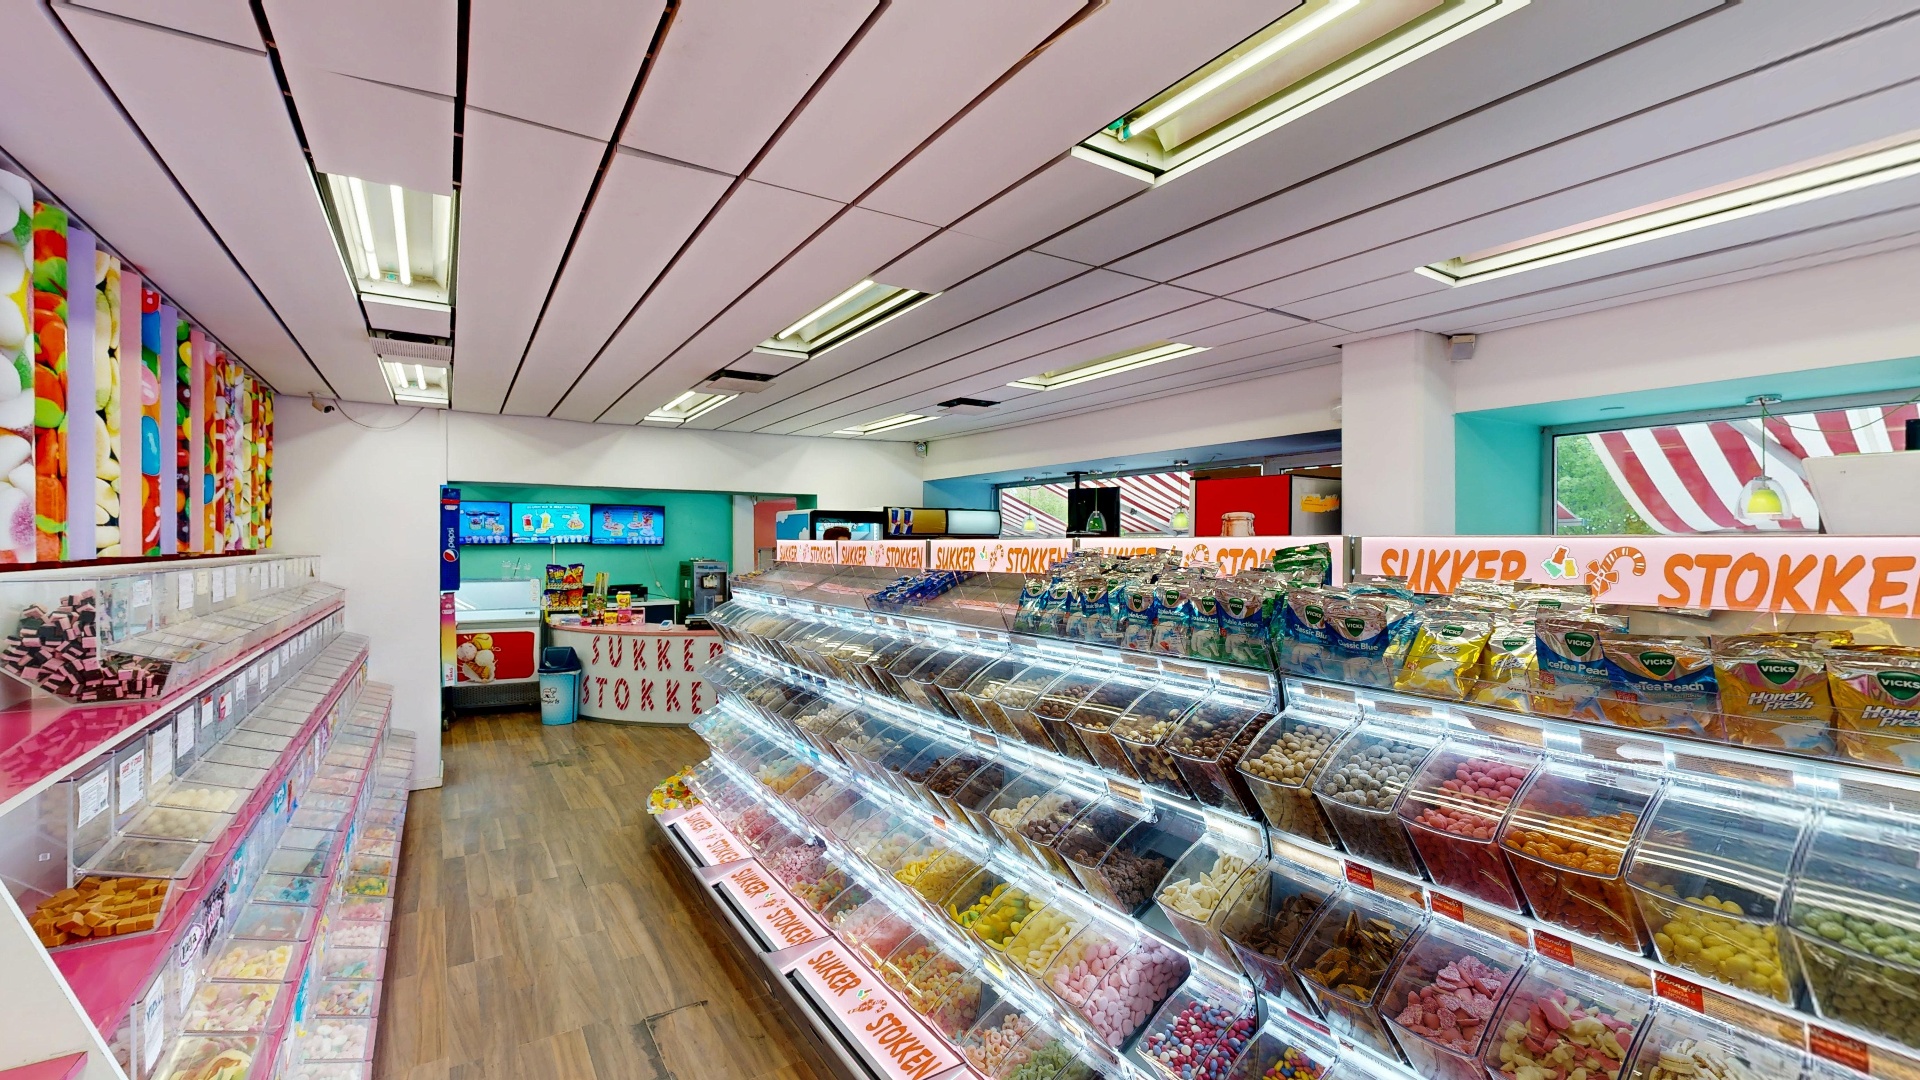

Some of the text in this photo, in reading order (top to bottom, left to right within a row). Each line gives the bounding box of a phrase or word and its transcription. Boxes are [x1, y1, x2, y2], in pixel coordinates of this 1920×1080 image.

[447, 527, 456, 549] pepsi
[780, 545, 835, 563] SUKKER STOKKEN
[841, 546, 924, 568] SUKKER STOKKEN
[935, 546, 976, 571] SUKKER
[1380, 548, 1527, 593] SUKKER
[1657, 552, 1920, 618] STOKKE
[1306, 610, 1322, 619] VICKS
[1294, 623, 1328, 640] Classic Blu
[1441, 628, 1463, 636] VICKS
[1338, 640, 1379, 652] Classic Blue
[1567, 639, 1592, 648] VICKS
[1547, 660, 1577, 672] IceTea
[1760, 665, 1796, 673] VICKS
[1664, 682, 1705, 693] Peach
[1881, 678, 1920, 690] VICKS
[583, 675, 719, 714] STOKKE
[1747, 692, 1808, 706] Honey
[1762, 696, 1815, 712] Fresh
[684, 812, 741, 864] SUKKER STOKKE
[731, 867, 817, 945] SUKKER STOKKEN
[807, 950, 943, 1080] SUKKER STOKKEN
